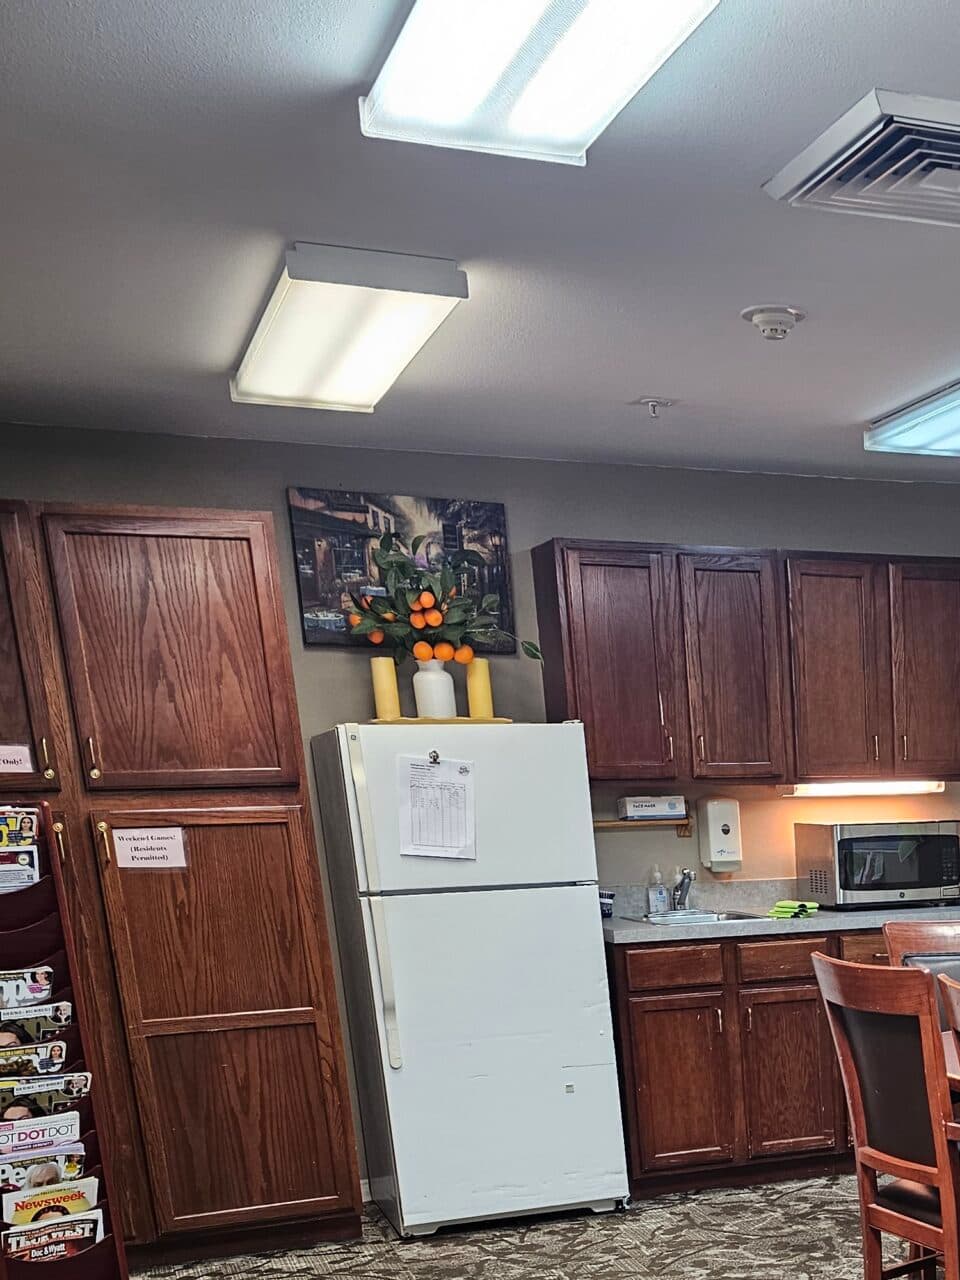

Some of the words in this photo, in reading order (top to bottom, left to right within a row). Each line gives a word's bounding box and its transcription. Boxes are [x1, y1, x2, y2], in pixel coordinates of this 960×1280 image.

[18, 1128, 48, 1142] DOT
[48, 1124, 76, 1137] DOT
[15, 1191, 86, 1212] Newsweek
[31, 1248, 43, 1258] Doc
[48, 1242, 66, 1255] Wyatt
